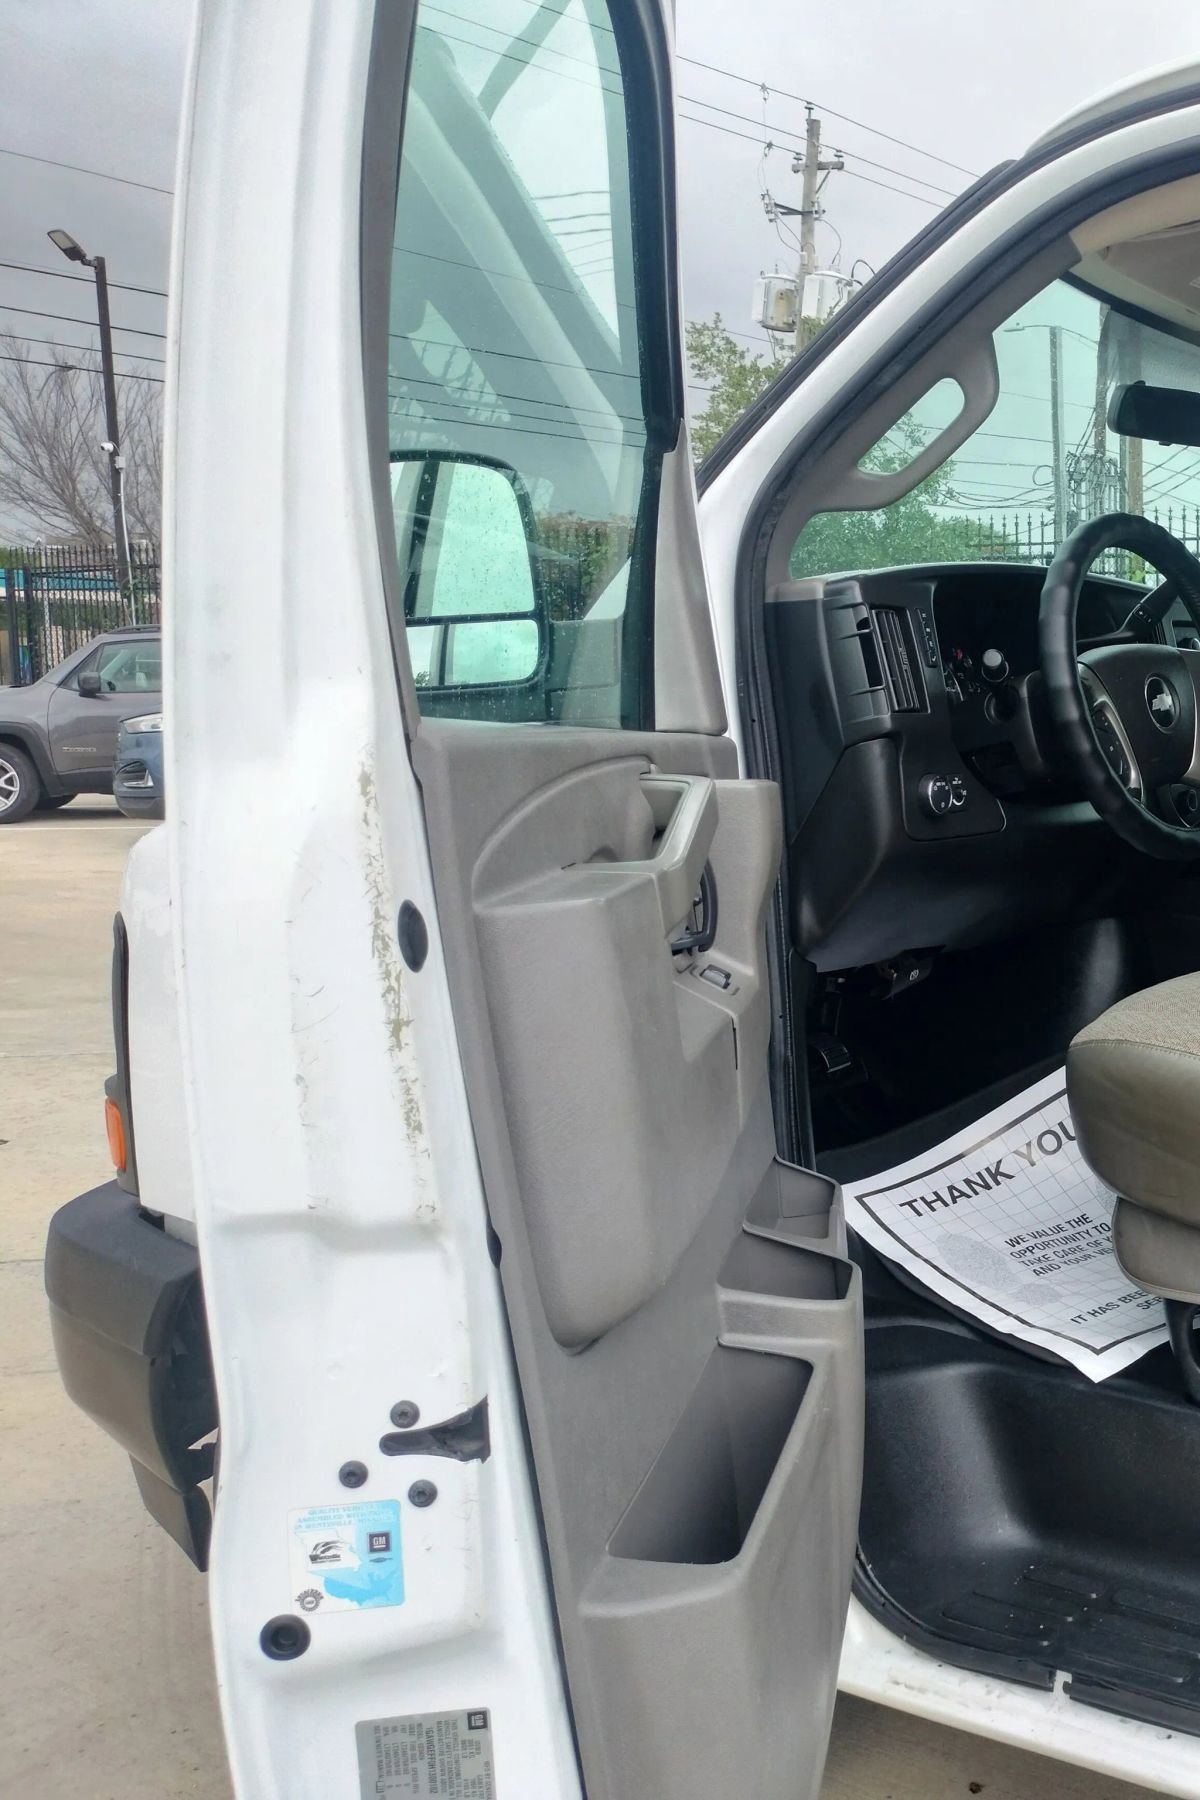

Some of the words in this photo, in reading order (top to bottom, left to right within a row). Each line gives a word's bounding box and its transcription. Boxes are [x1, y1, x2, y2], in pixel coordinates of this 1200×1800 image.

[899, 1159, 1016, 1217] THANK
[1004, 1234, 1030, 1248] WE
[1026, 1223, 1068, 1240] VALUE
[1065, 1213, 1094, 1229] THE
[1009, 1229, 1093, 1259] OPPORTUNITY
[1091, 1222, 1112, 1235] TO
[1019, 1253, 1055, 1267] TAKE
[1053, 1244, 1088, 1259] CARE
[1086, 1239, 1104, 1249] OF
[1032, 1263, 1062, 1277] AND
[1060, 1253, 1097, 1266] YOUR
[1070, 1314, 1088, 1325] IT
[1087, 1302, 1120, 1317] HAS
[1117, 1289, 1151, 1304] BEE
